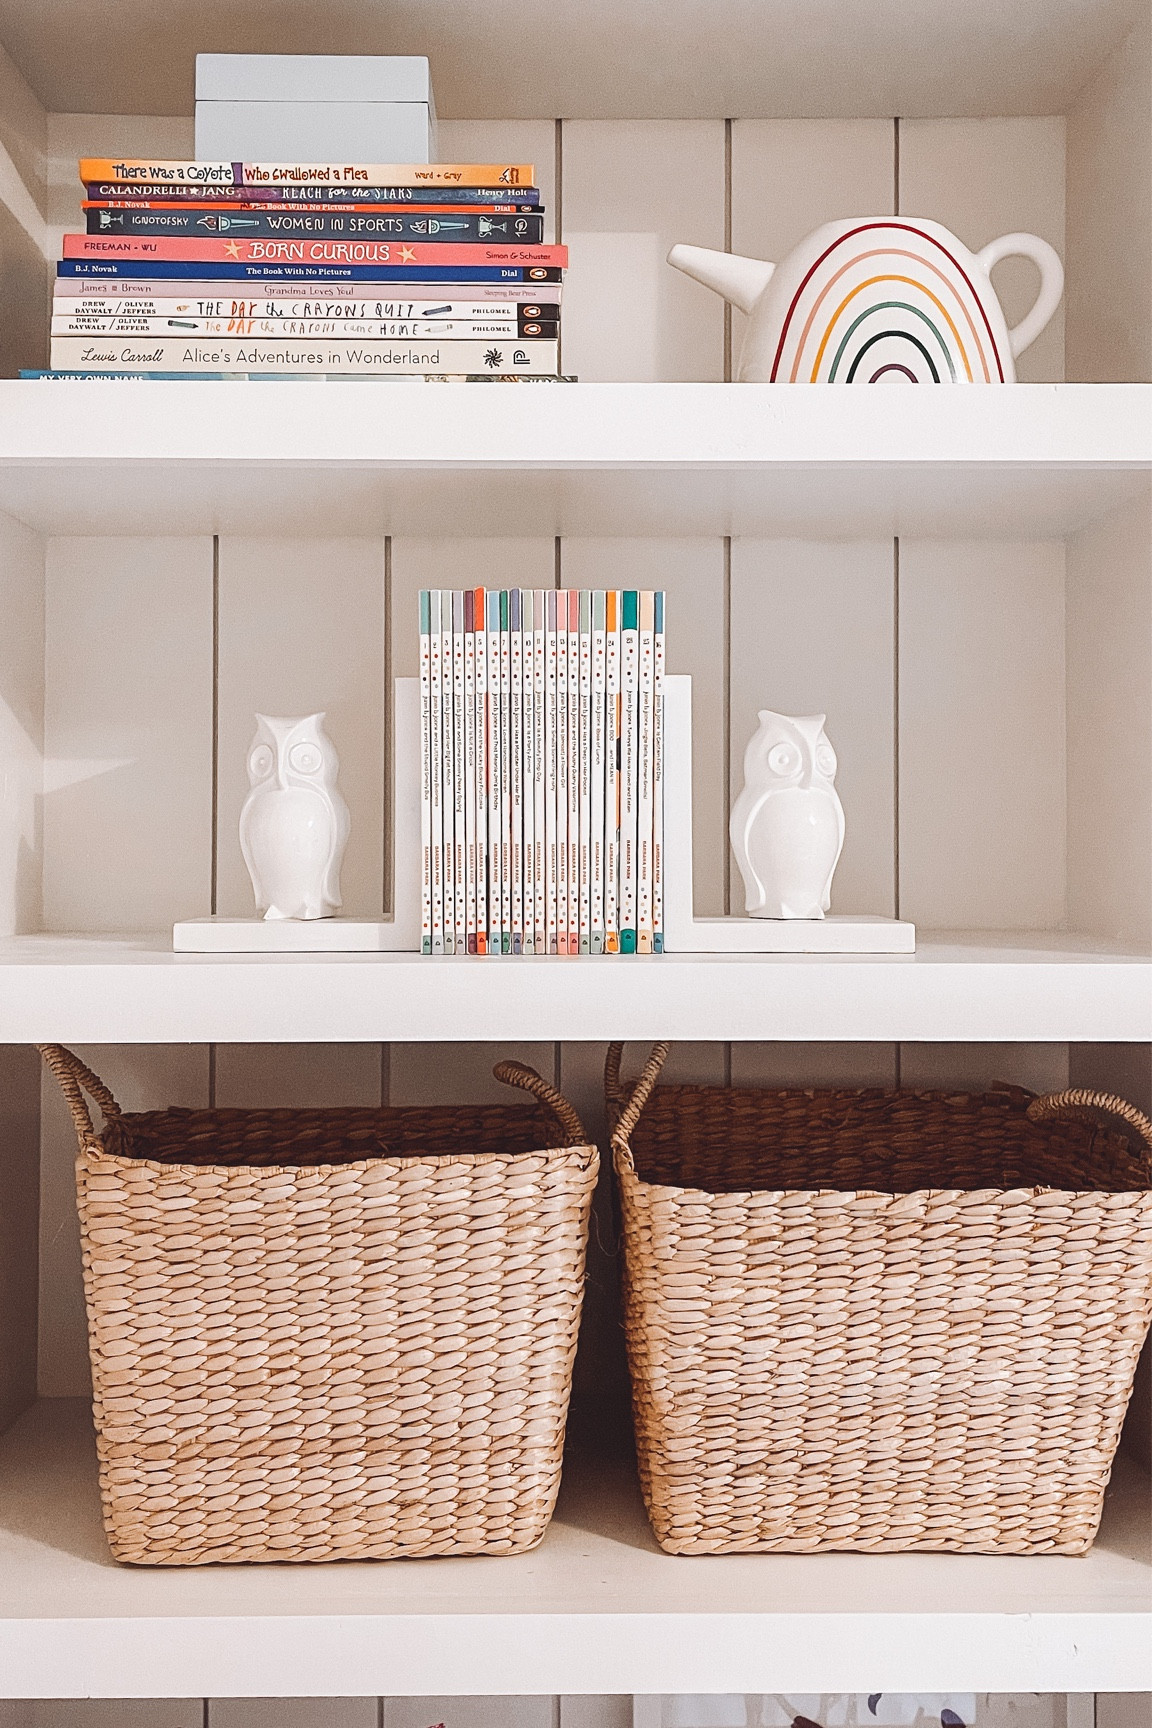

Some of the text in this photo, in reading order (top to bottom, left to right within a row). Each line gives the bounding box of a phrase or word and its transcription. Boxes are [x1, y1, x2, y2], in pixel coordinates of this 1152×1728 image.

[112, 163, 232, 182] There Was a Coyote
[245, 166, 369, 181] Who Swallowed a Flea
[99, 185, 235, 196] CALANDRELLI JANG
[282, 187, 322, 199] REACH
[327, 187, 348, 199] for
[351, 187, 371, 198] the
[477, 189, 527, 198] Henry Holt
[124, 201, 151, 209] Novak
[267, 203, 287, 211] Book
[288, 203, 309, 211] With
[132, 216, 189, 226] IGNOTOFSKY
[267, 216, 403, 232] WOMEN IN SPORTS
[84, 242, 131, 251] FREEMAN
[141, 244, 158, 252] WU
[247, 242, 390, 262] BORN CURIOUS
[486, 251, 508, 259] Simon
[520, 252, 551, 260] Schuster
[75, 265, 118, 273] B.J. Novak
[246, 267, 262, 275] The
[263, 267, 284, 275] Book
[319, 268, 351, 276] Pictures
[79, 282, 152, 293] James Brown
[264, 285, 354, 296] Grandma Loves You!
[197, 301, 414, 318] THE DAY the CRAYONS QUIT
[205, 321, 221, 332] The
[227, 318, 256, 334] DAY
[261, 321, 275, 333] the
[380, 323, 419, 336] HOME
[81, 348, 164, 362] Lewis Carroll
[182, 348, 440, 364] Alice's Adventures in Wonderland
